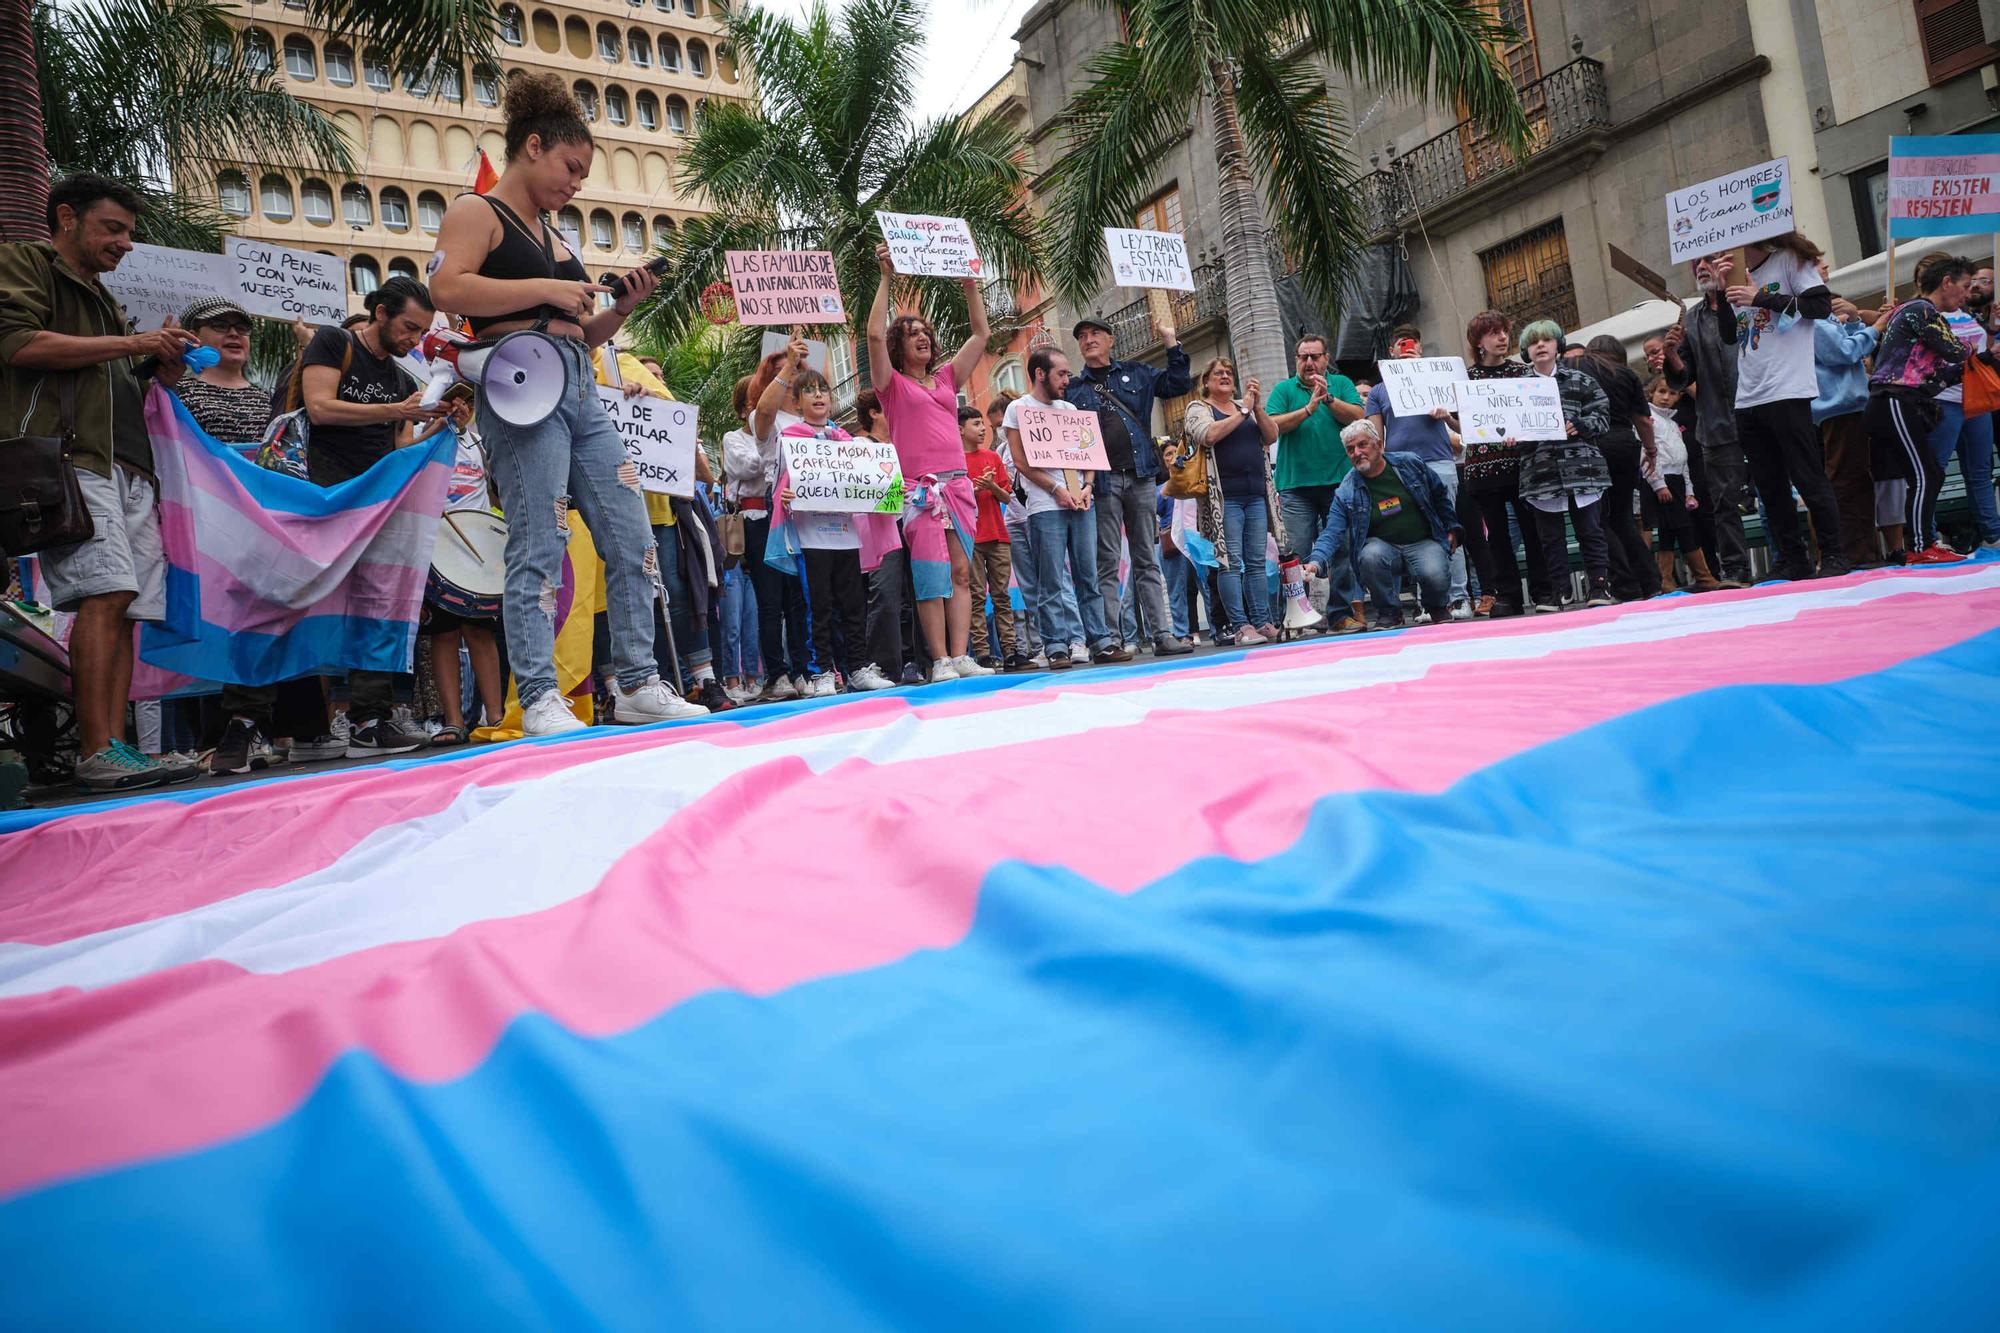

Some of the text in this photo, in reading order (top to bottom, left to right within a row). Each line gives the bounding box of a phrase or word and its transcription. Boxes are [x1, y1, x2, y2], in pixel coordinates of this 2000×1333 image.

[1674, 164, 1782, 214] LOS HOMBRES
[1932, 178, 1990, 196] EXISTEN
[1694, 202, 1746, 222] trans
[1906, 198, 1972, 218] RESISTEN
[882, 216, 898, 228] Mi
[888, 230, 969, 247] salud y mente
[1120, 234, 1182, 254] LEY TRANS
[1672, 226, 1725, 254] TAMBIÉN
[893, 246, 908, 254] no
[140, 250, 208, 273] FAMILIA
[236, 243, 324, 276] CON PENE
[731, 254, 832, 273] LAS FAMILIAS DE
[1130, 250, 1184, 268] ESTATAL
[256, 266, 285, 282] CON
[292, 274, 338, 292] VAGINA
[737, 275, 836, 293] LA INFANCIA TRANS
[108, 284, 151, 298] TIENE
[154, 290, 178, 300] UNA
[136, 300, 182, 314] TRANS
[282, 300, 346, 320] COMBATIVAS
[740, 296, 820, 315] NO SE RINDEN
[1410, 362, 1424, 372] TE
[1401, 376, 1413, 387] MI
[1466, 384, 1496, 396] LES
[343, 384, 370, 403] ANS
[1399, 388, 1426, 410] CIS
[1488, 394, 1522, 408] NIÑES
[632, 406, 652, 422] DE
[1024, 410, 1092, 426] SER TRANS
[1472, 413, 1506, 428] SOMOS
[612, 419, 672, 444] UTILAR
[1029, 427, 1080, 442] NO ES
[790, 442, 808, 456] NO
[816, 444, 832, 456] ES
[1030, 450, 1052, 460] UNA
[800, 470, 884, 484] SOY TRANS Y
[796, 486, 840, 500] QUEDA
